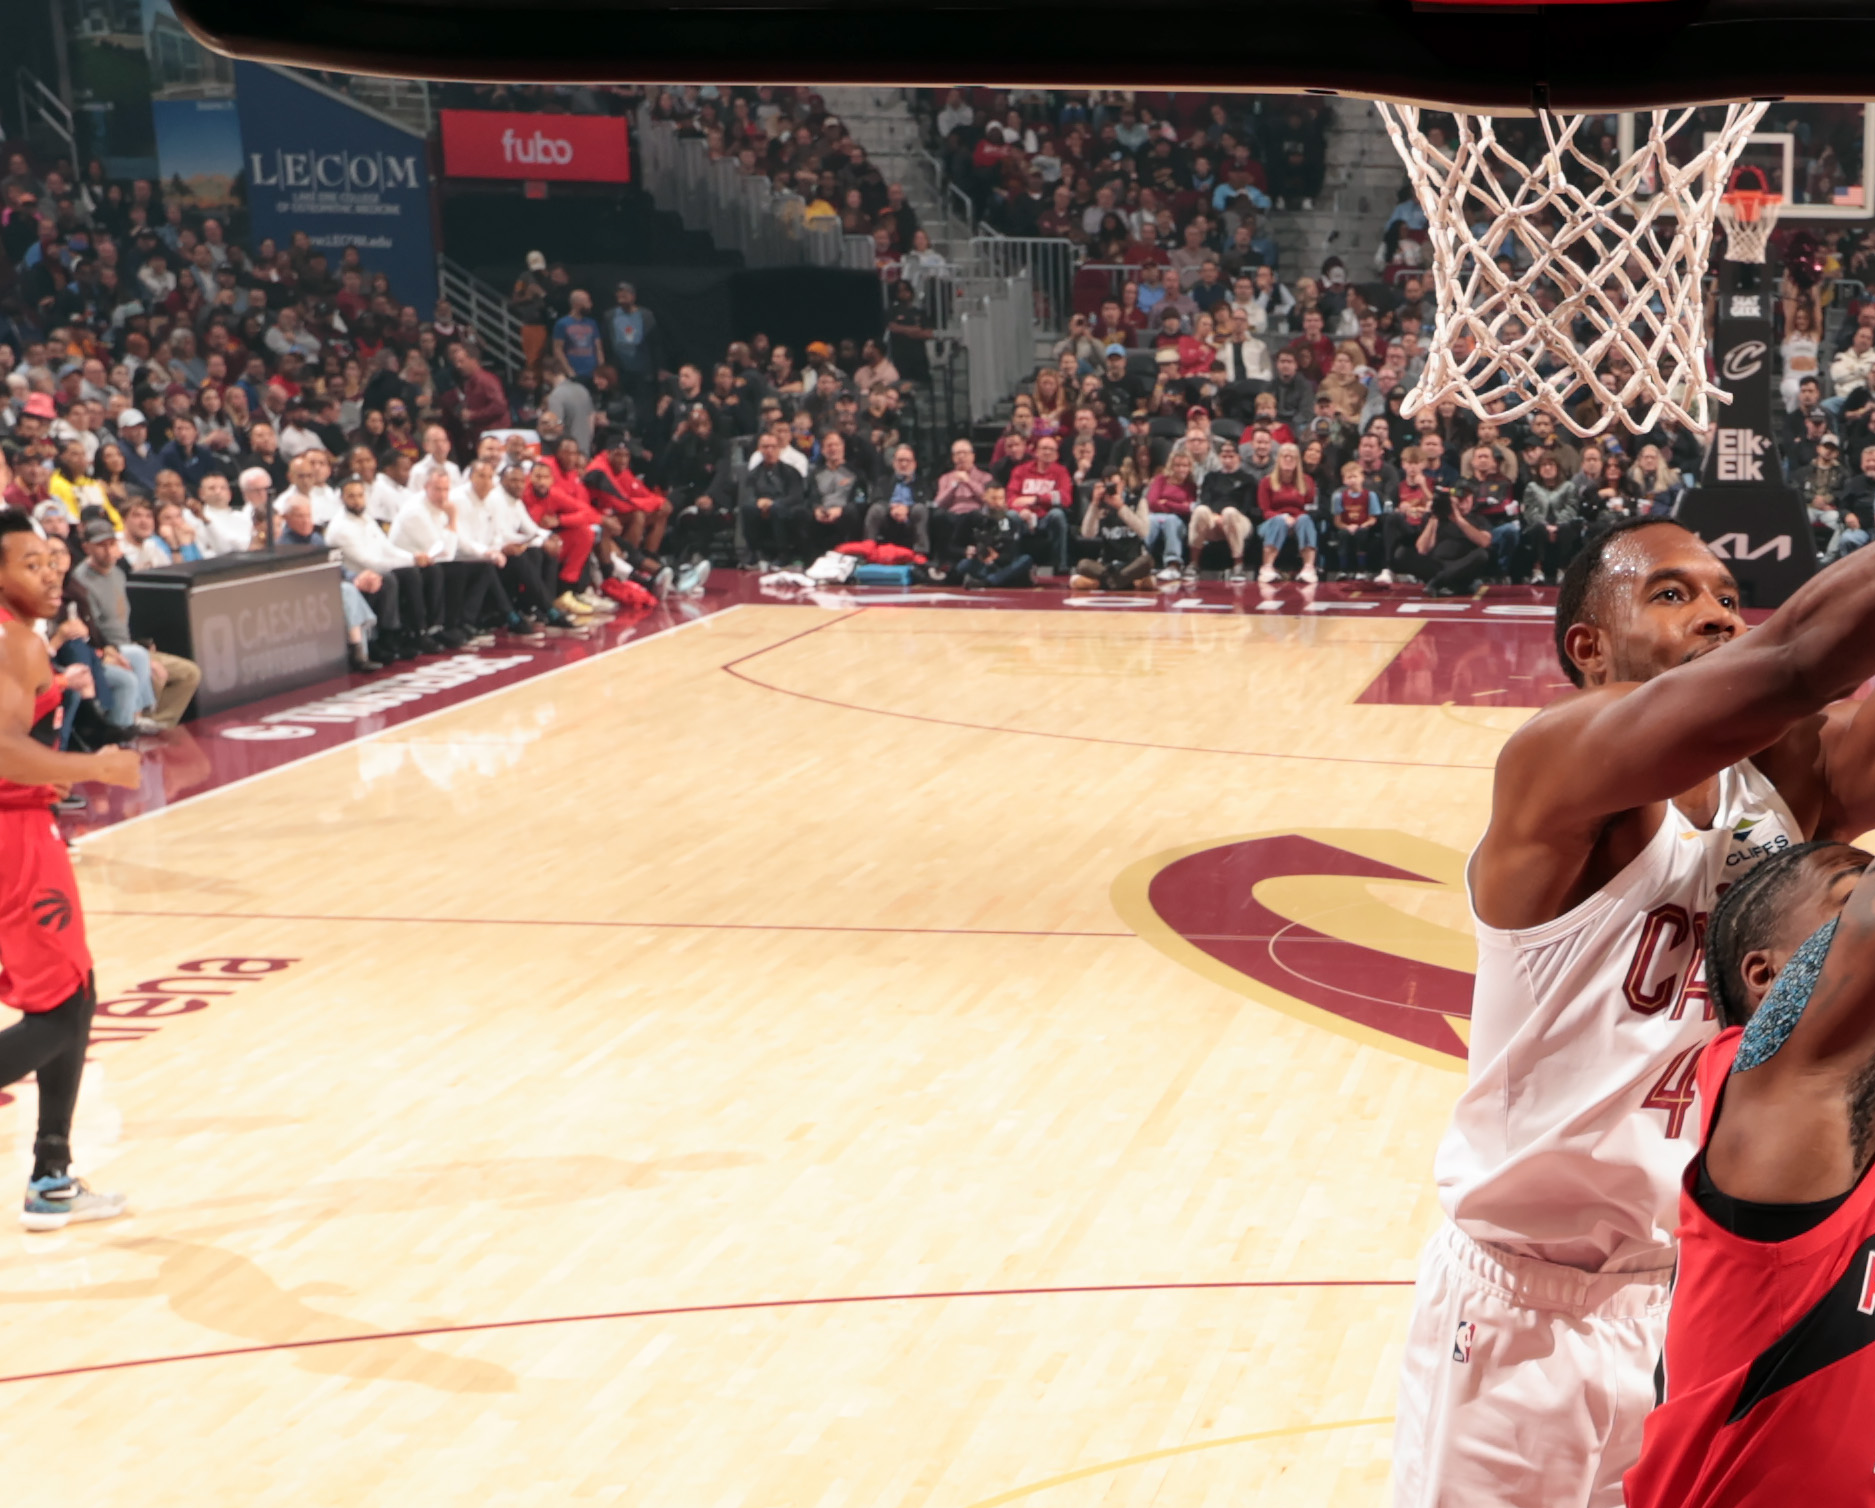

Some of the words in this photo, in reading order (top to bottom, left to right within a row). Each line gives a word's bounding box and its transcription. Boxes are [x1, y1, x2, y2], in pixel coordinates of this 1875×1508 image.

[502, 129, 574, 164] fubo
[1717, 456, 1764, 480] Elk
[239, 592, 332, 650] CAESARS
[1726, 835, 1789, 866] CLIFFS
[1622, 902, 1717, 1021] CA
[1641, 1040, 1700, 1140] 4
